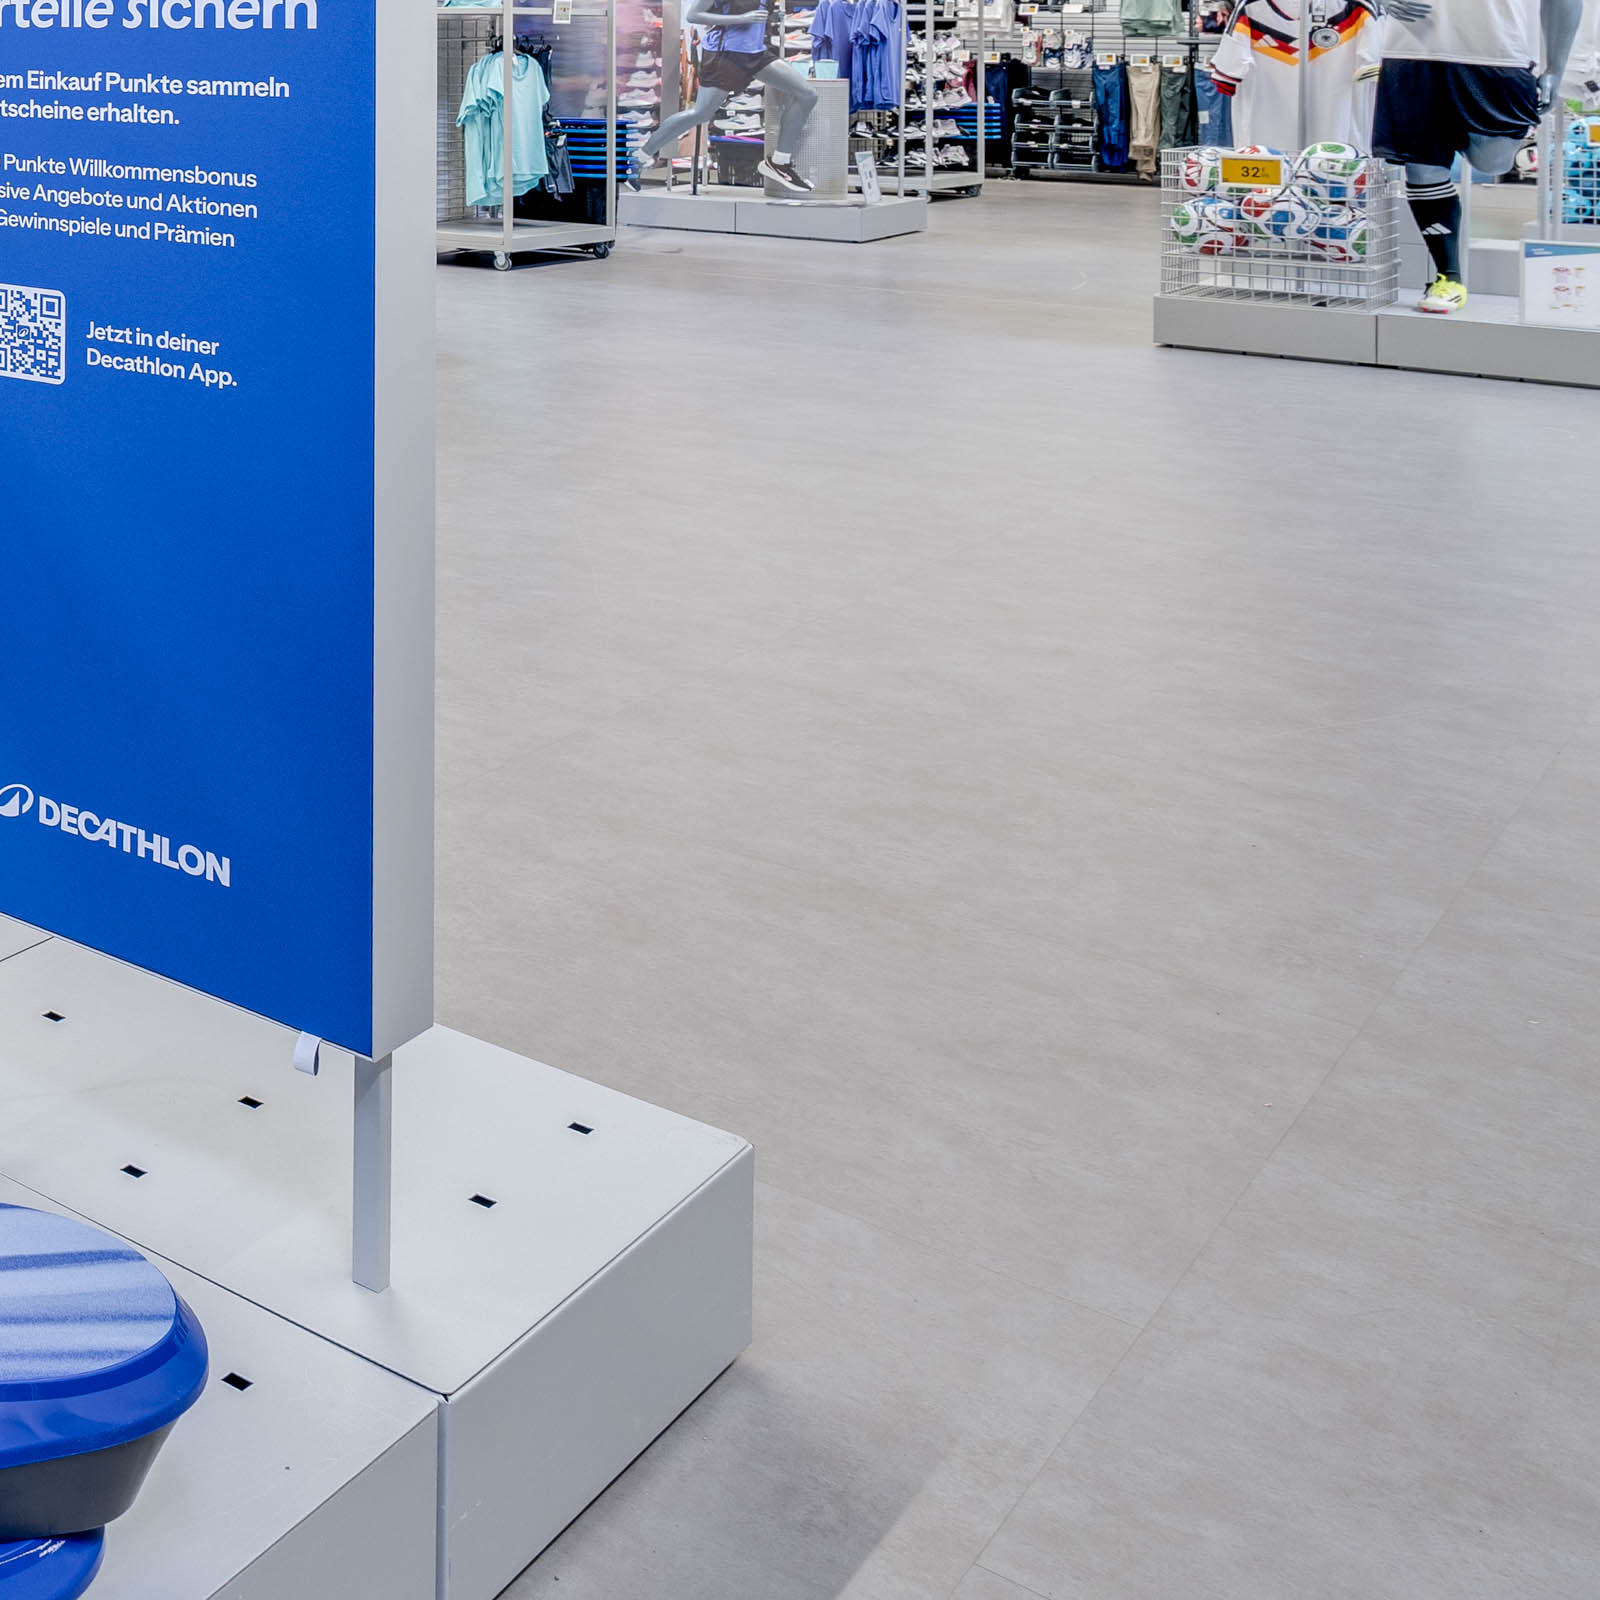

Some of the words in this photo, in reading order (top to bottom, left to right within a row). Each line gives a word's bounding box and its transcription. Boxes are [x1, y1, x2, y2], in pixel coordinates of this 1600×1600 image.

[27, 70, 102, 92] Einkauf
[105, 72, 183, 95] Punkte
[186, 76, 290, 98] sammeln
[87, 103, 180, 125] erhalten.
[3, 154, 66, 175] Punkte
[69, 157, 258, 188] Willkommensbonus
[1240, 166, 1261, 178] 32
[33, 184, 124, 208] Angebote
[126, 192, 163, 211] und
[166, 194, 259, 219] Aktionen
[114, 221, 151, 240] und
[154, 223, 235, 248] Prämien
[86, 321, 133, 345] Jetzt
[135, 327, 153, 347] in
[156, 330, 220, 356] deiner
[86, 347, 186, 379] Decathlon
[188, 362, 238, 389] App.
[38, 795, 232, 888] DECATHLON
